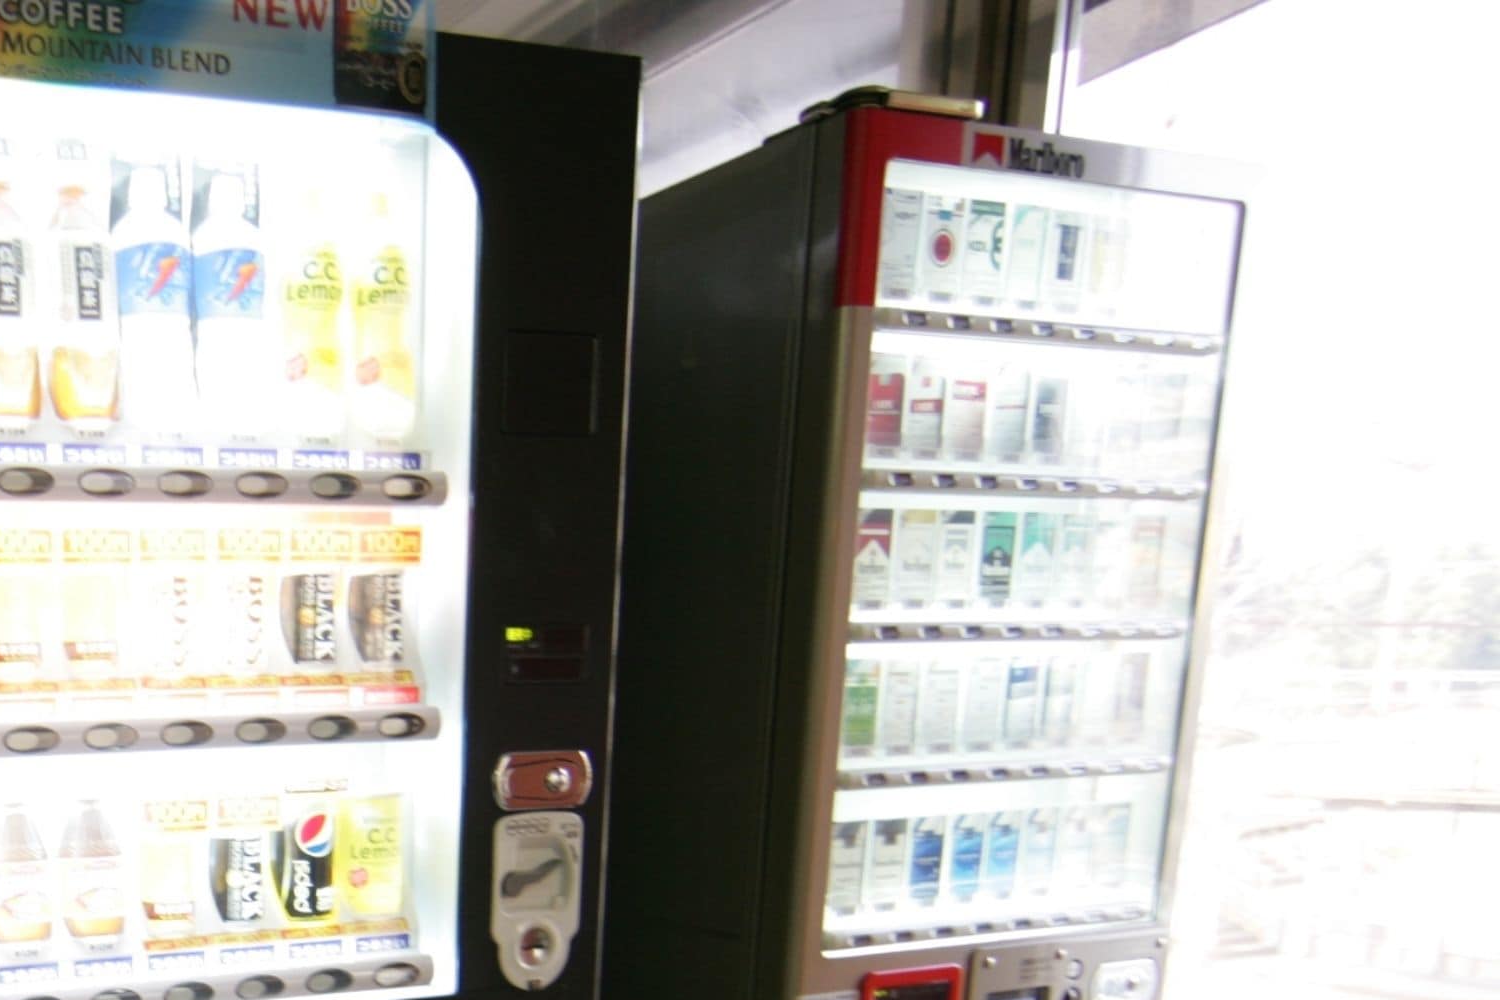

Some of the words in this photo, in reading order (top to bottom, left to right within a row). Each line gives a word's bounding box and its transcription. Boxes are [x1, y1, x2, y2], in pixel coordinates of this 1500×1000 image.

[232, 0, 329, 32] NEW
[1, 28, 144, 66] MOUNTAIN
[151, 48, 231, 75] BLEND
[1009, 137, 1085, 179] Marlboro
[314, 574, 336, 661] BLACK
[386, 574, 404, 662] BLACK
[242, 838, 263, 921] BLACK
